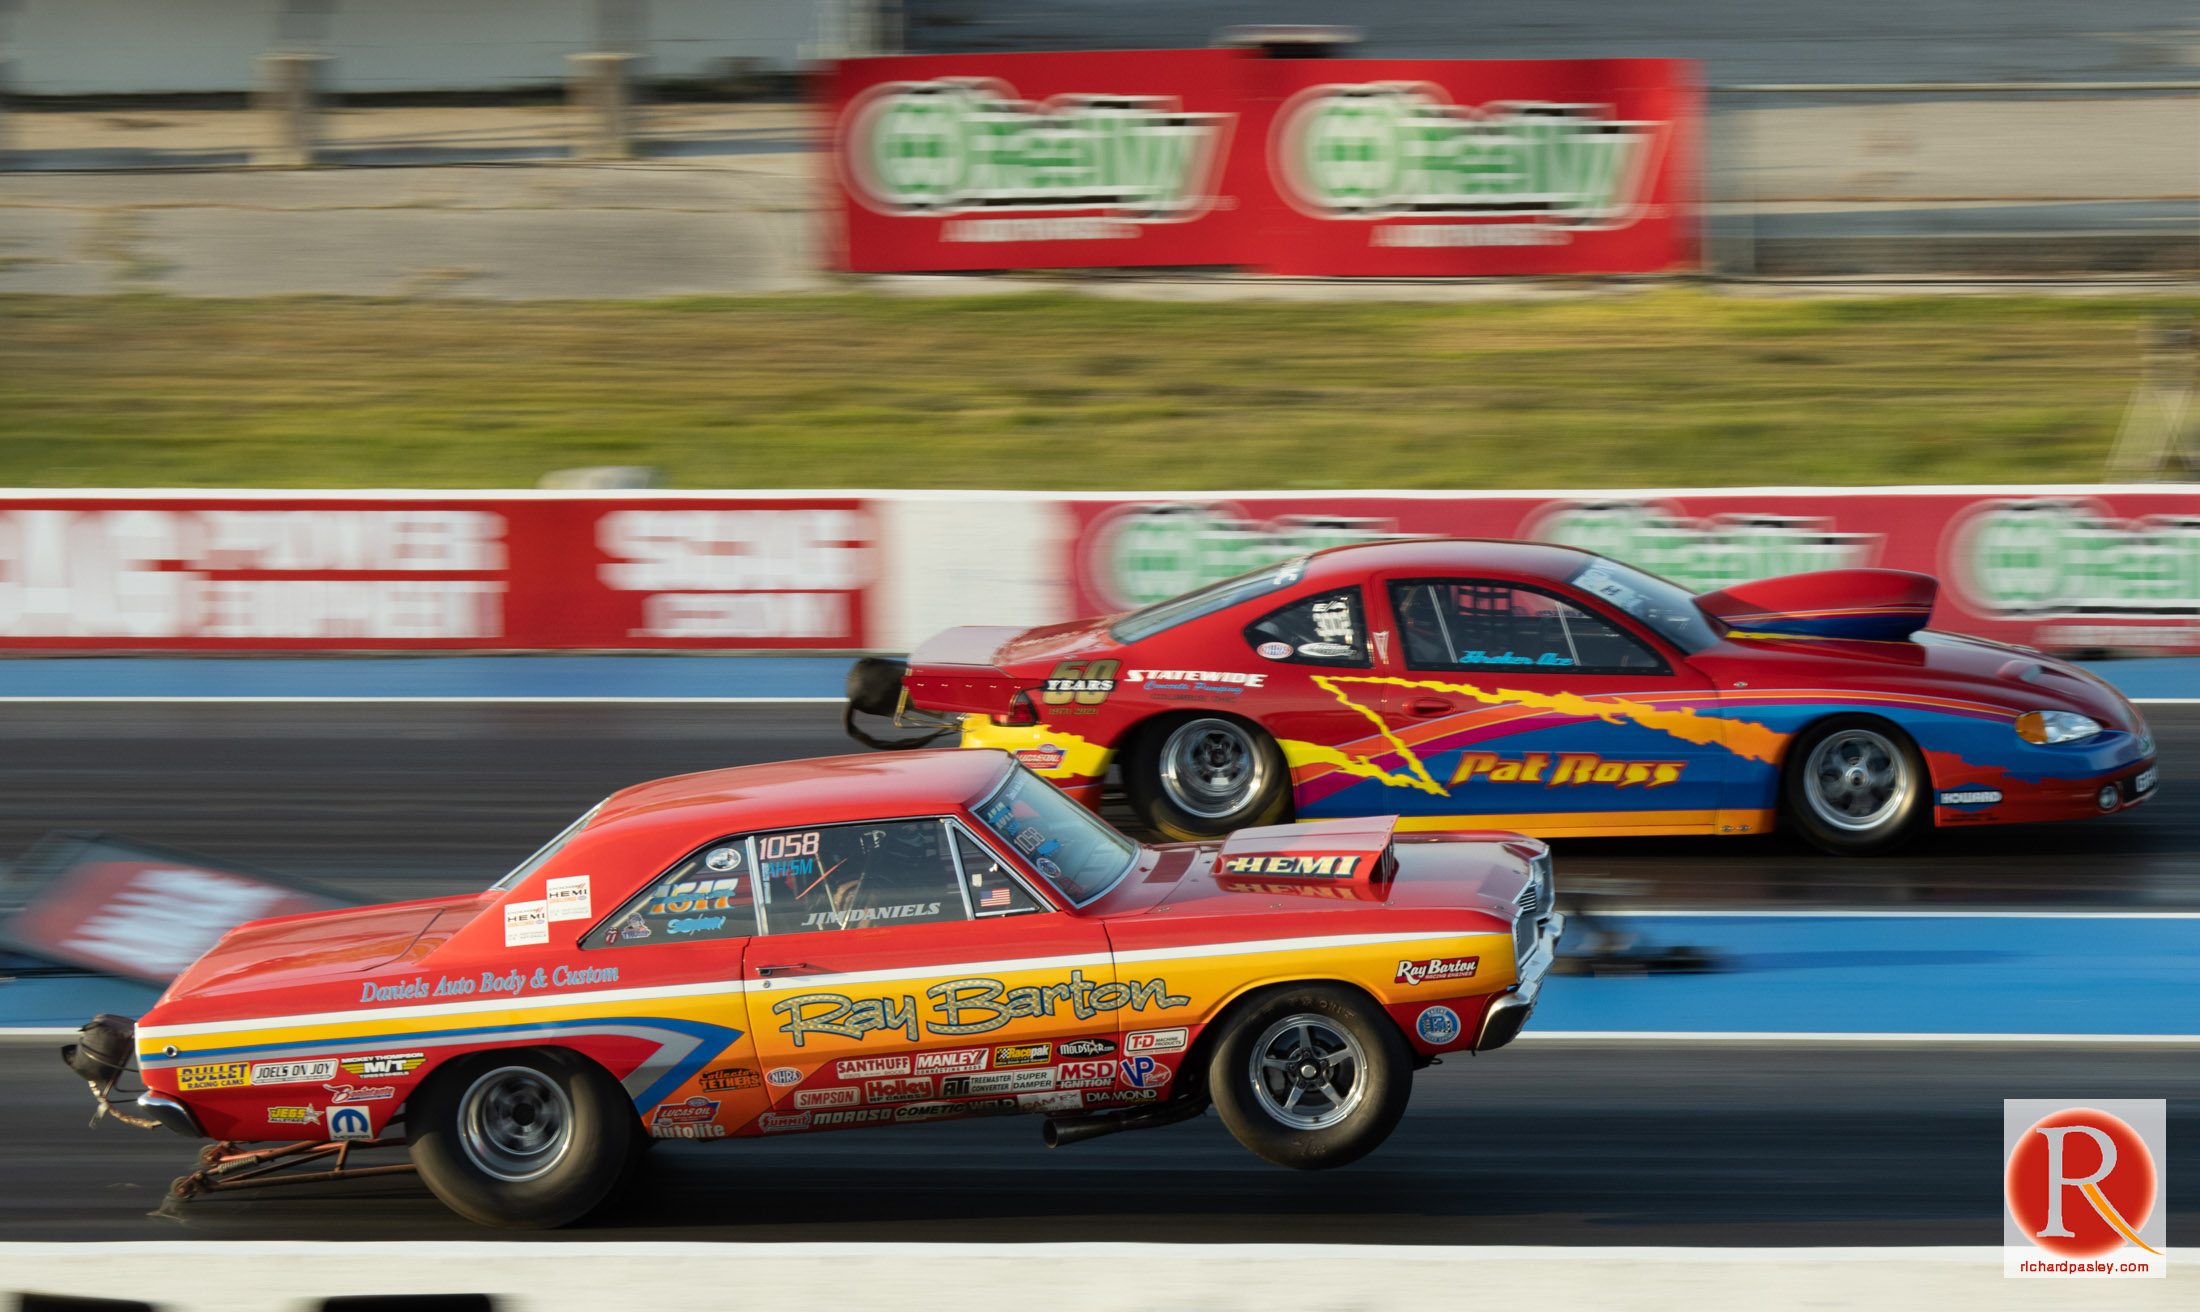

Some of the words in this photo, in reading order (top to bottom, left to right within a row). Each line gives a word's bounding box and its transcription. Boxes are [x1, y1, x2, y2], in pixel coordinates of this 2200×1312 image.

[1047, 680, 1114, 690] YEARS
[1123, 669, 1268, 688] STATEWIDE
[1446, 750, 1551, 789] Pat
[1546, 751, 1688, 790] Ross
[760, 832, 820, 861] 1058
[1013, 827, 1046, 855] 1058
[1226, 855, 1361, 878] HEMI
[549, 889, 587, 898] HEMI
[507, 913, 545, 922] HEMI
[801, 908, 847, 927] JIM
[846, 902, 941, 922] DANIELS
[1397, 961, 1428, 985] Ray
[1427, 959, 1477, 975] Barton
[360, 978, 430, 1003] Daniels
[432, 975, 476, 997] Auto
[479, 969, 526, 995] Body
[530, 967, 548, 988] &
[553, 965, 619, 987] Custom
[773, 993, 919, 1047] Ray
[926, 970, 1191, 1034] Barton
[1132, 1034, 1155, 1049] T&D
[1008, 1044, 1050, 1059] Racepak
[363, 1059, 407, 1073] M/T
[838, 1058, 909, 1074] SANTHUFF
[917, 1052, 977, 1069] MANLEY
[181, 1063, 249, 1082] BULLET
[255, 1063, 289, 1079] JOELS
[292, 1063, 307, 1077] ON
[311, 1062, 331, 1076] JOY
[771, 1071, 799, 1084] NHRA
[916, 1066, 964, 1075] CONNECTING
[1016, 1072, 1047, 1081] SUPER
[1061, 1062, 1113, 1081] MSD
[1121, 1056, 1155, 1087] VP
[187, 1081, 219, 1090] RACING
[220, 1079, 245, 1088] CAMS
[699, 1075, 760, 1089] TETHERS
[971, 1074, 1012, 1083] TREEMASTER
[1013, 1080, 1052, 1090] DAMPER
[1060, 1078, 1112, 1089] IGNITION
[868, 1080, 932, 1098] Holley
[971, 1083, 1009, 1092] CONVERTER
[800, 1091, 854, 1106] SIMPSON
[1086, 1089, 1157, 1103] DIAMOND
[271, 1108, 306, 1119] JEGS
[661, 1108, 694, 1117] LUCAS
[694, 1107, 711, 1116] OIL
[897, 1103, 966, 1116] COMETIC
[652, 1123, 725, 1138] Autolite
